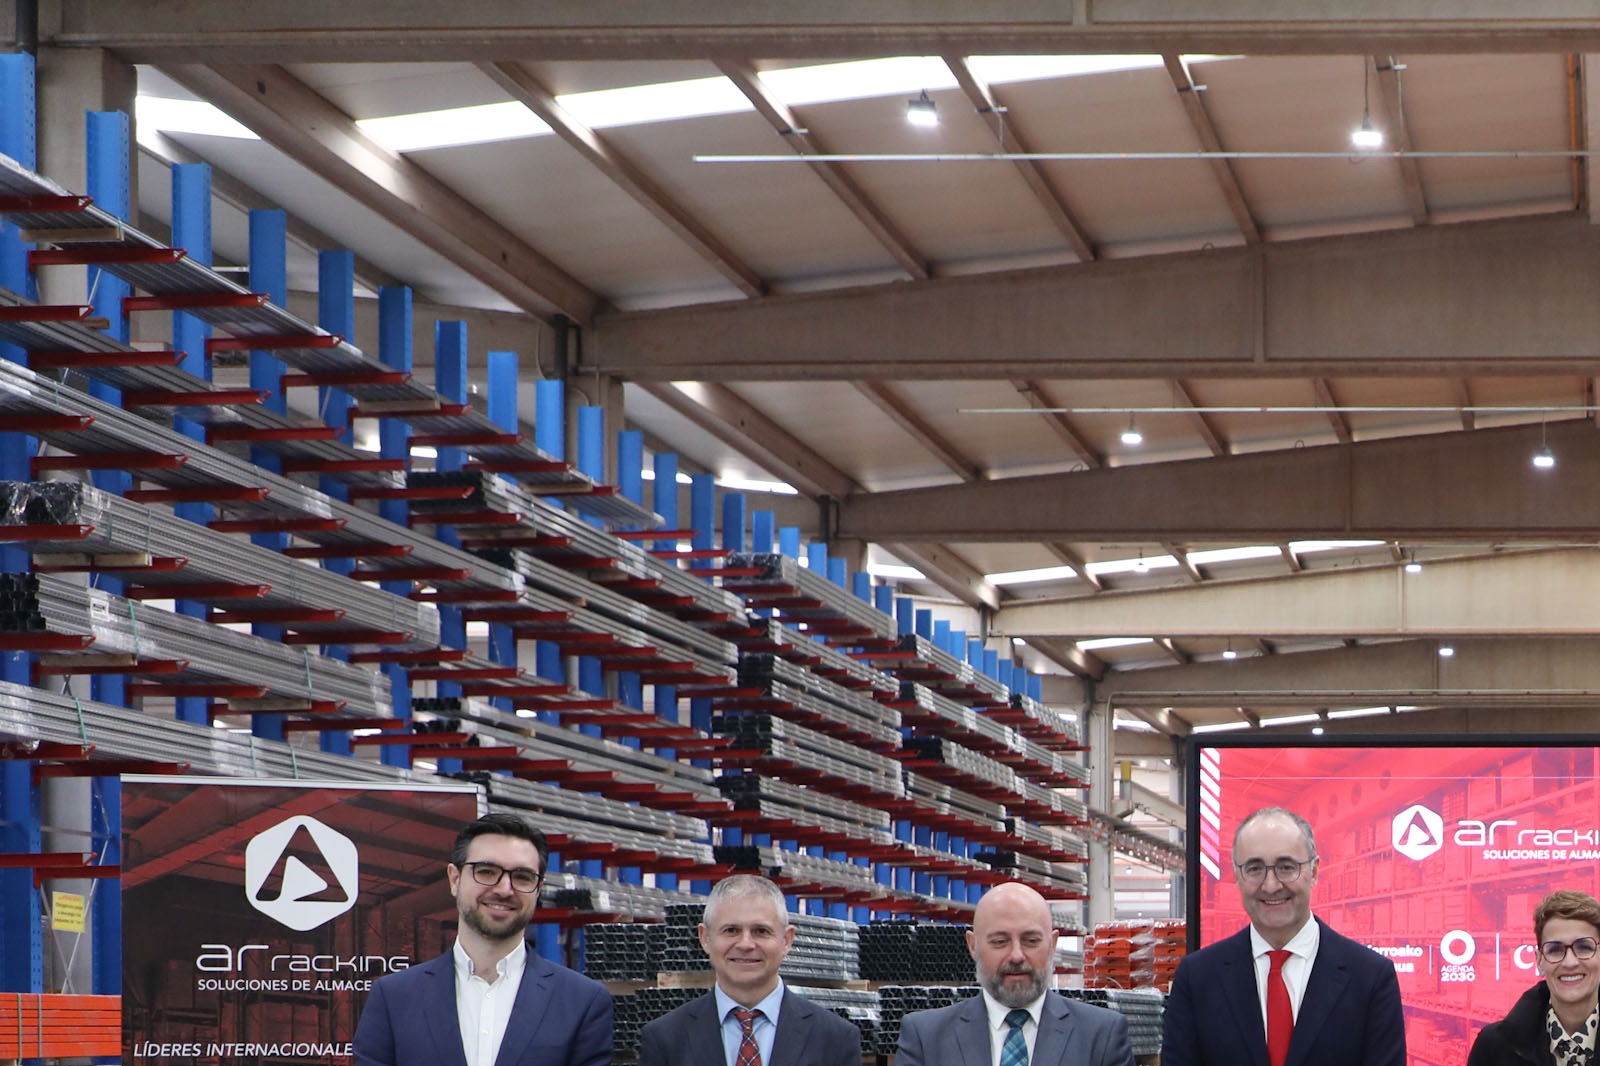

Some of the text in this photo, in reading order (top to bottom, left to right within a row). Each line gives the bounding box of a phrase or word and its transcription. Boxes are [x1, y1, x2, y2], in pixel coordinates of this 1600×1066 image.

[1483, 850, 1550, 860] SOLUCIONES
[1552, 850, 1567, 860] DE
[1440, 965, 1475, 973] AGENDA
[1440, 972, 1476, 982] 2030
[198, 979, 288, 991] SOLUCIONES
[292, 979, 310, 991] DE
[133, 1041, 201, 1057] LÍDERES
